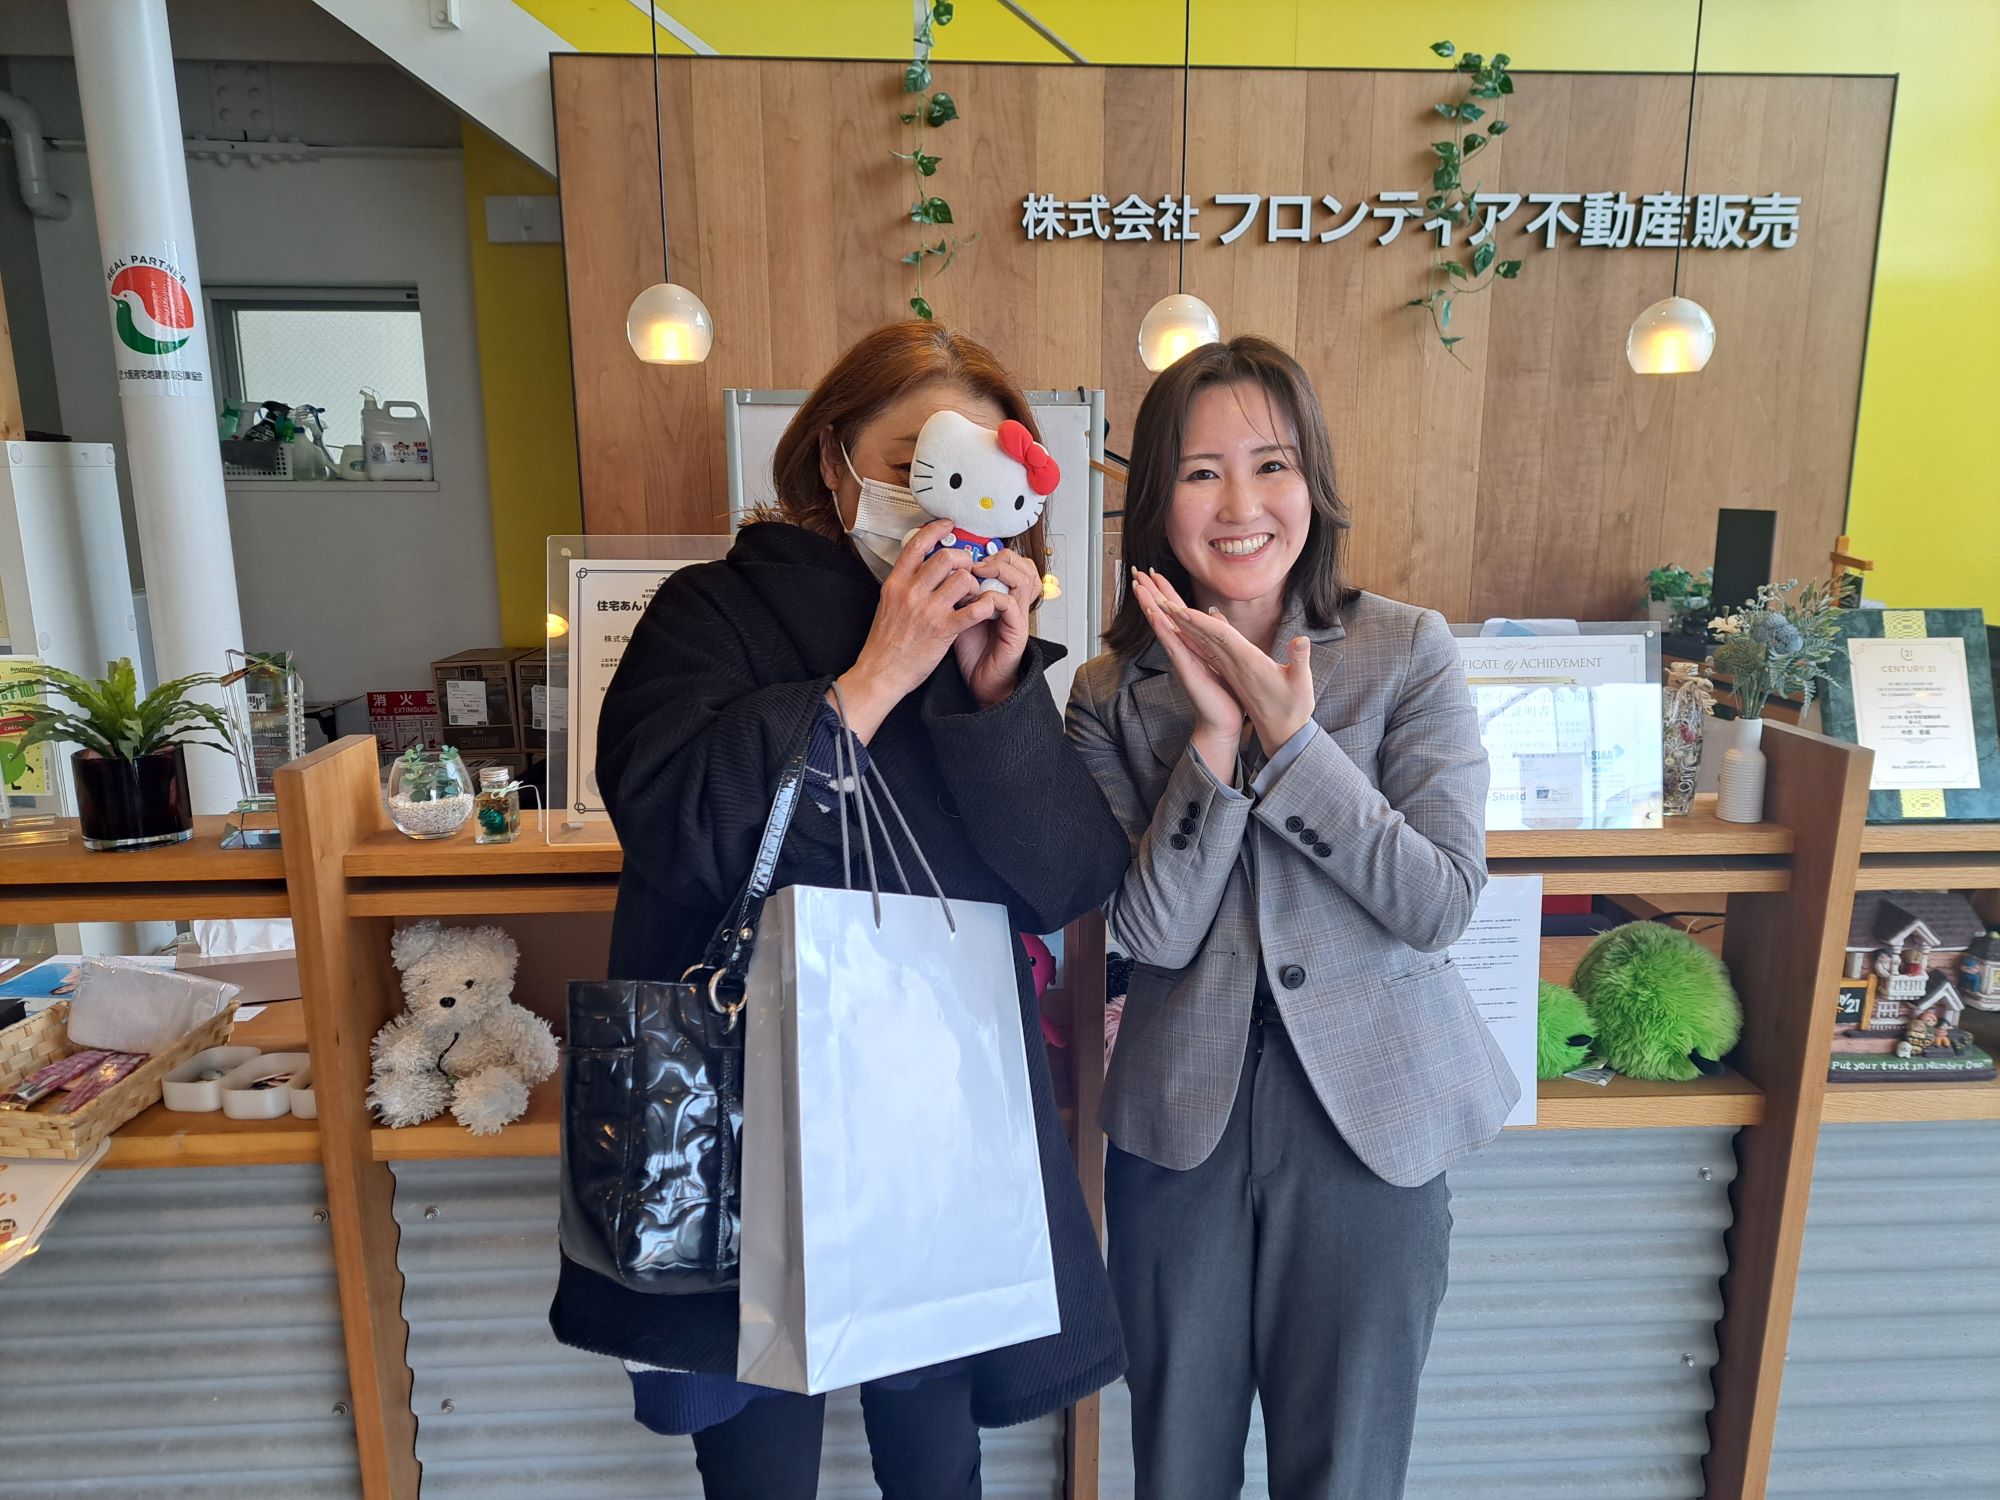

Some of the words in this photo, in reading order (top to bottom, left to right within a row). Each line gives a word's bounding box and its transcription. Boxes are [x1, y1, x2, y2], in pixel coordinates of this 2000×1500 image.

[107, 259, 127, 281] REAL
[131, 255, 187, 284] PARTNER
[1462, 659, 1499, 670] FICATE
[1520, 657, 1603, 669] ACHIEVEMENT
[1881, 665, 1925, 673] CENTURY
[1927, 665, 1937, 673] 21
[1909, 1037, 1931, 1047] SOLD
[1832, 1061, 1851, 1070] Put
[1853, 1062, 1877, 1071] your
[1881, 1061, 1910, 1070] trust
[1912, 1062, 1924, 1070] in
[1925, 1061, 1963, 1070] Number
